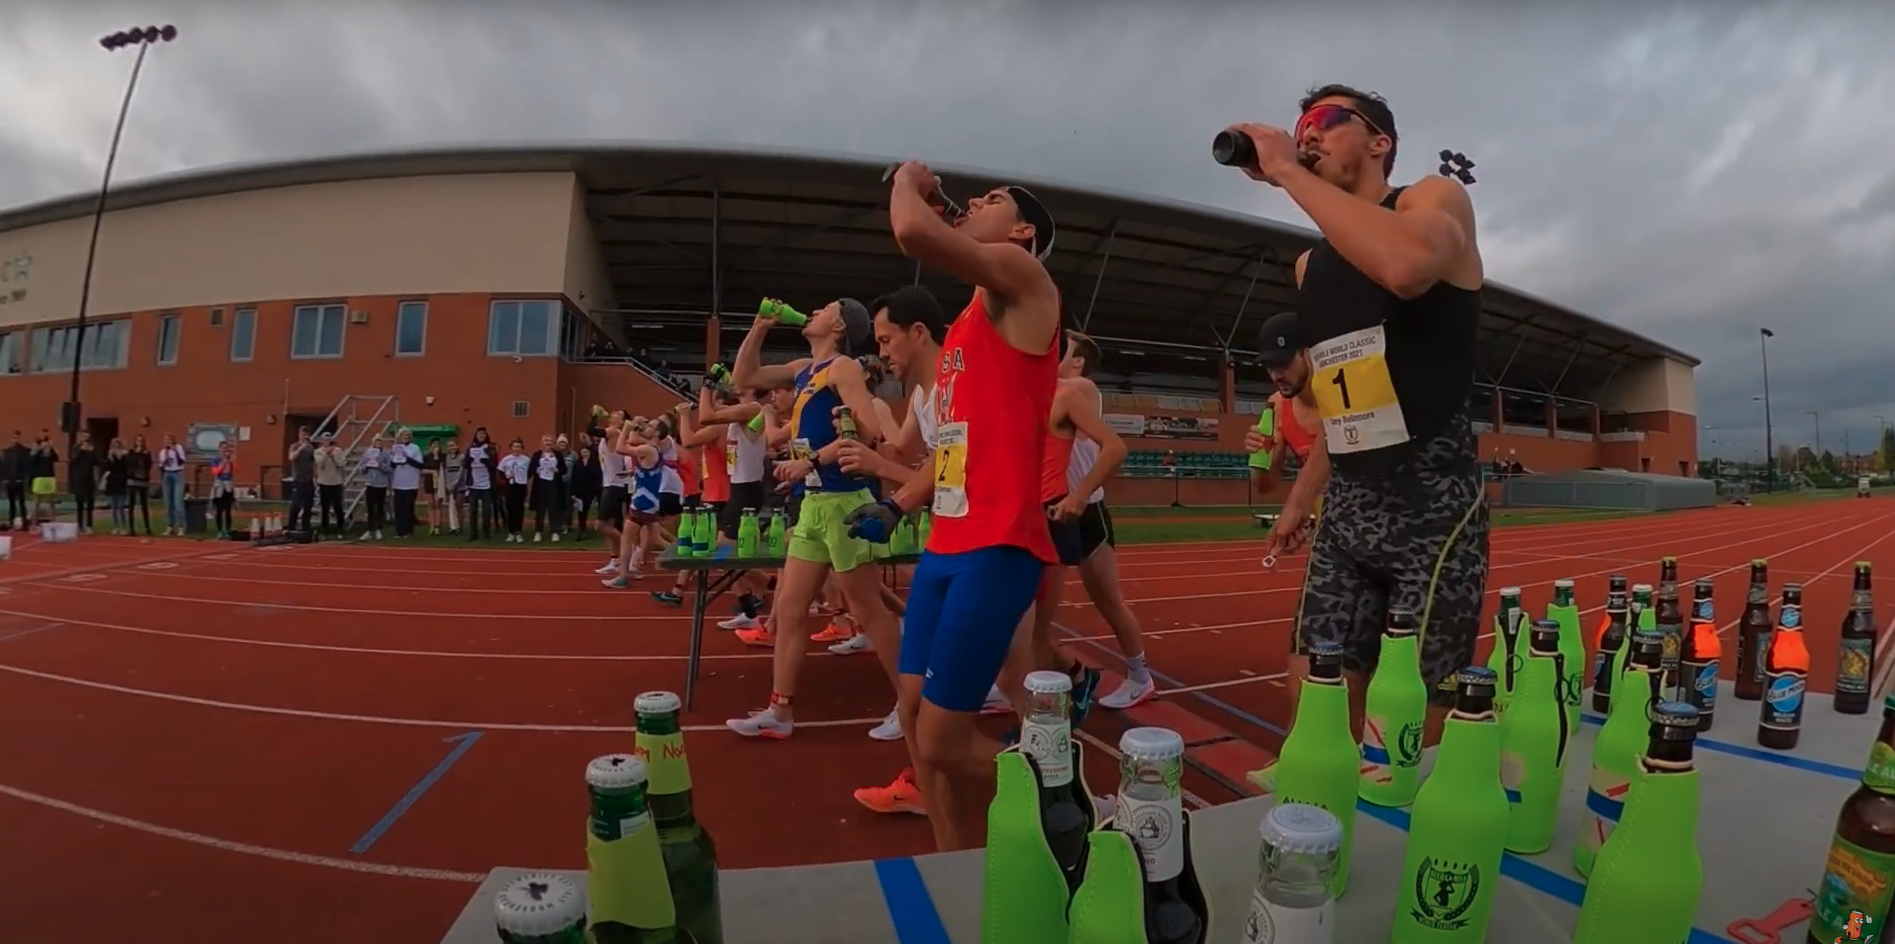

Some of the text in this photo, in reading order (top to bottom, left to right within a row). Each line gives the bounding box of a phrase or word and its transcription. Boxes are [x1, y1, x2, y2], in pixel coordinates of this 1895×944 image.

[1329, 342, 1349, 356] WORLD
[1349, 336, 1377, 349] CLASSIC
[1349, 348, 1363, 360] 2021
[1332, 367, 1351, 409] 1
[938, 449, 950, 482] 2
